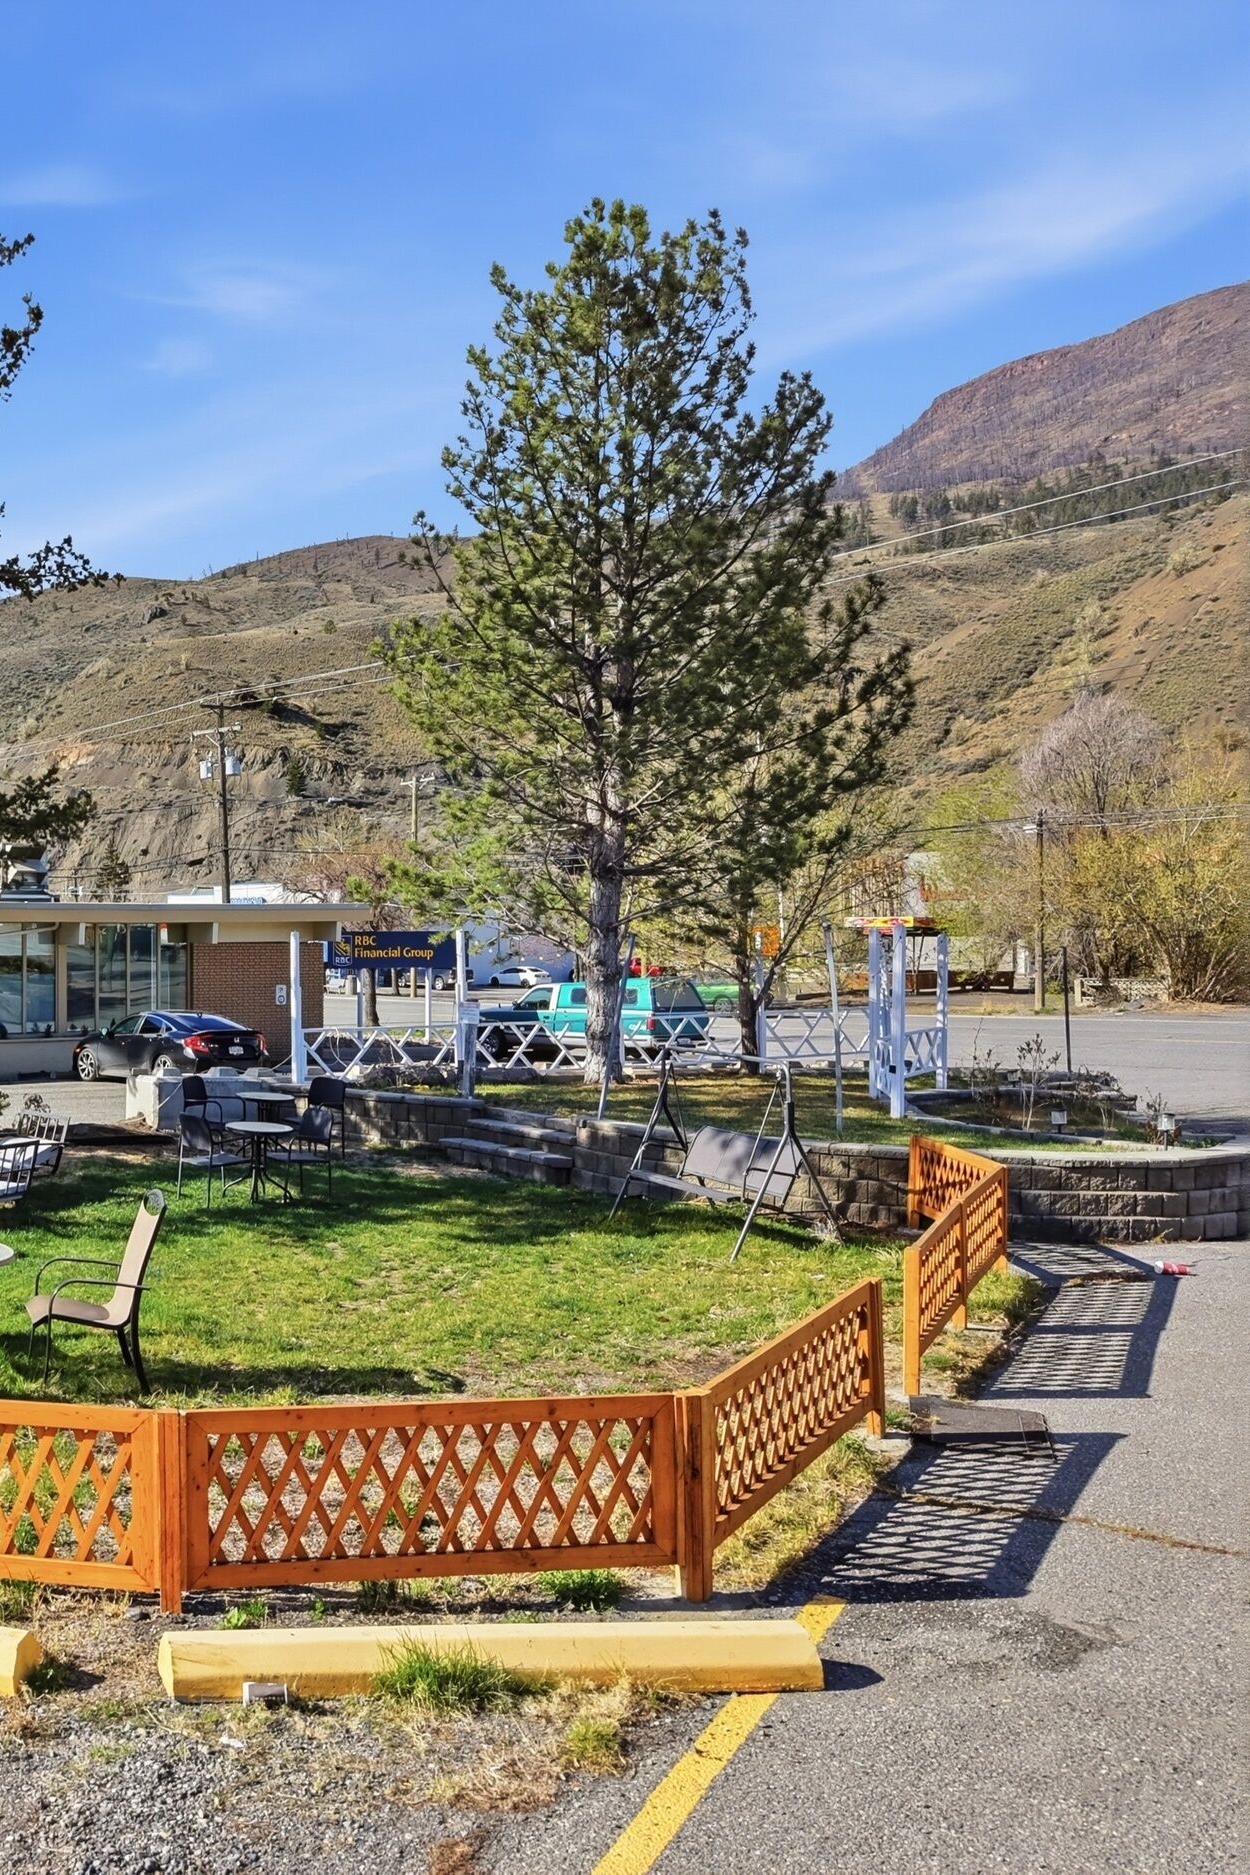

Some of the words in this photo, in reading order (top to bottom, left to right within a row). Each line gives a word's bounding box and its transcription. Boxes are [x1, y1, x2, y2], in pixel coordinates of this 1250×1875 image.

[354, 935, 377, 946] RBC
[354, 946, 401, 958] Financial
[403, 947, 434, 960] Group
